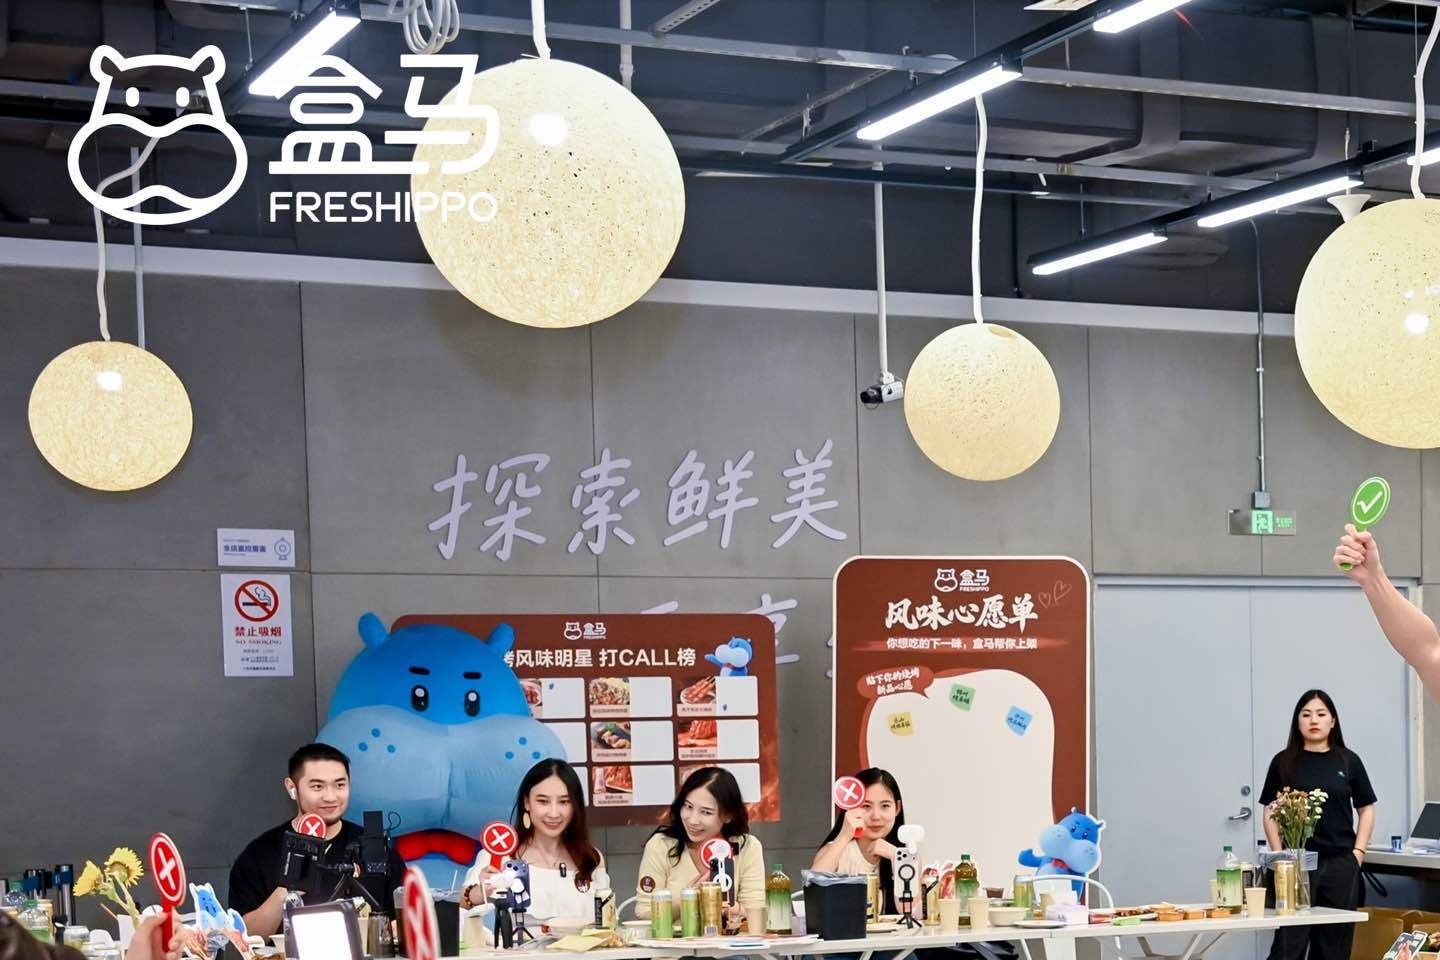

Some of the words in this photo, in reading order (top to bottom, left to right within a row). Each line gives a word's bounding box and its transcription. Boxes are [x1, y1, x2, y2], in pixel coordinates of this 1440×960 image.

[429, 439, 848, 561] 探索鲜美
[959, 569, 990, 586] 盒马
[885, 593, 1038, 633] 风味心愿单
[234, 626, 282, 637] 禁止吸烟
[599, 648, 697, 668] 打CALL榜
